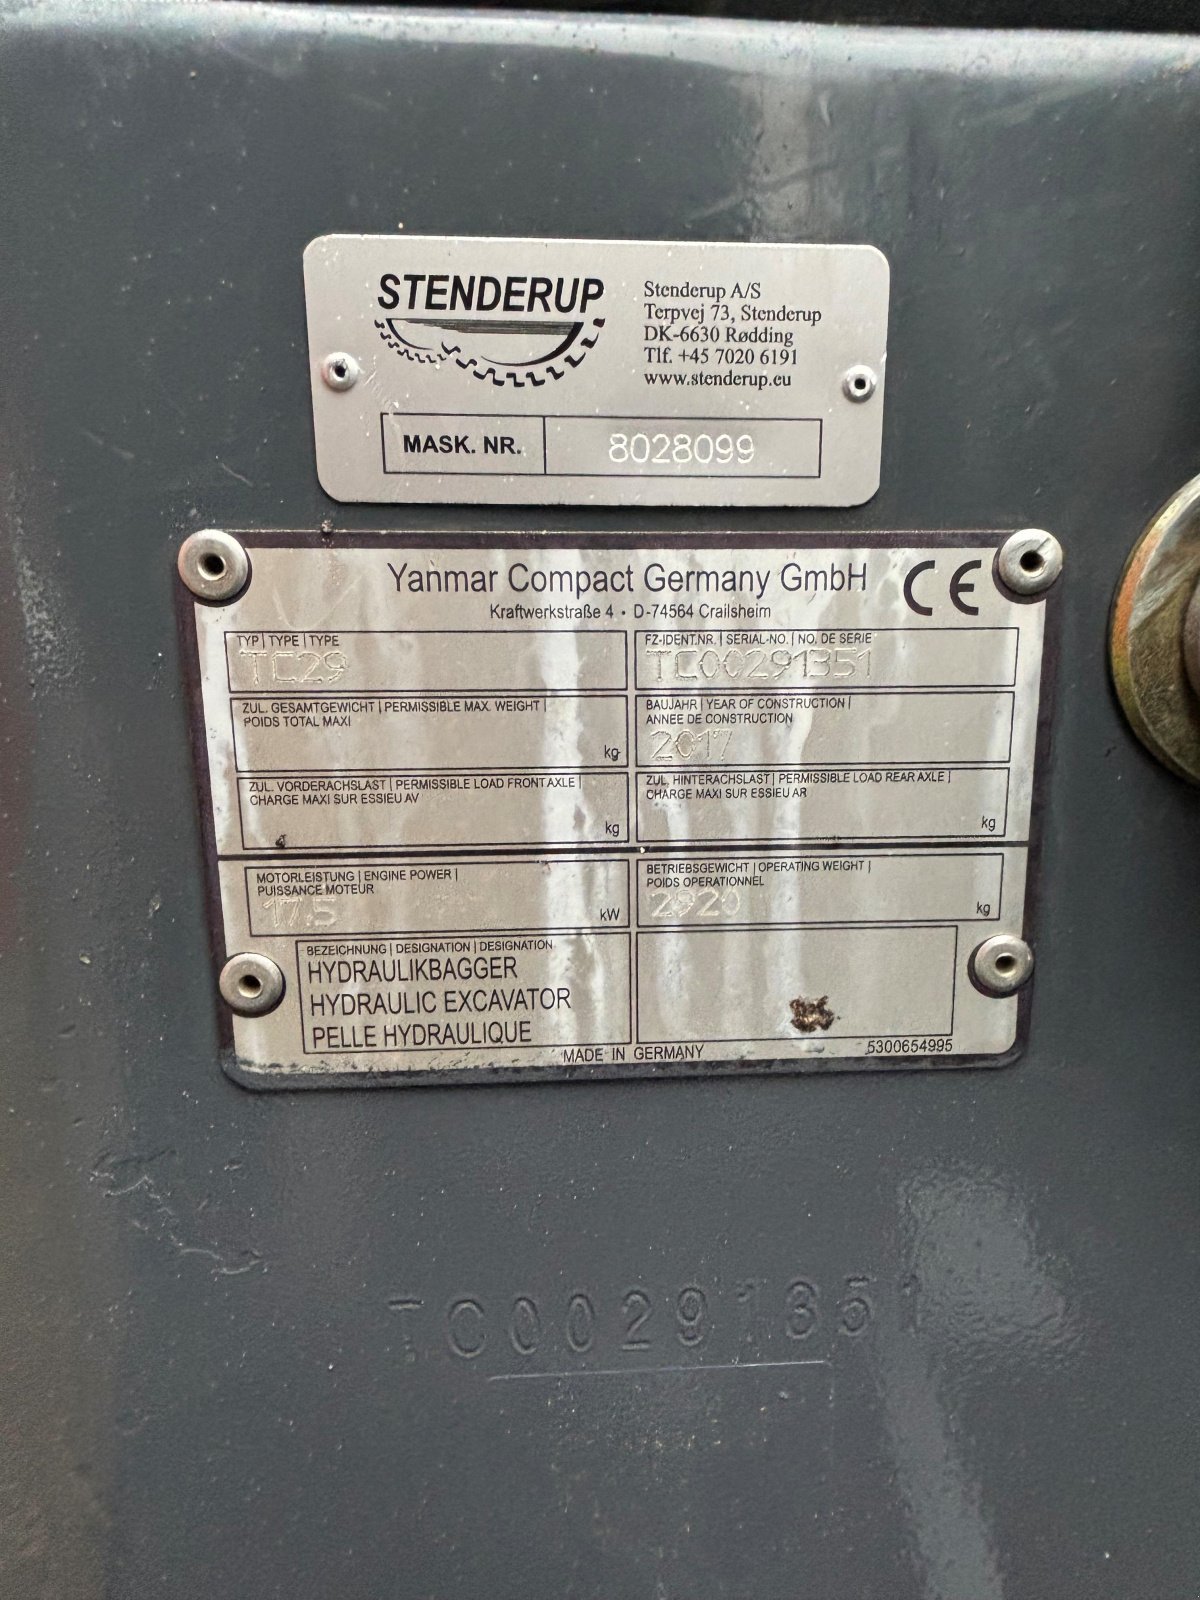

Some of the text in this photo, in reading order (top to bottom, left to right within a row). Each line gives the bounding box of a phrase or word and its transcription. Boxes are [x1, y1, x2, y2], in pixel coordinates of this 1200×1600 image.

[377, 273, 604, 313] STENDERUP
[644, 281, 761, 302] Stenderup A/S
[644, 303, 822, 326] Terpvej 73, Stenderup
[644, 325, 793, 347] DK-6630 Rødding
[644, 347, 797, 365] Tlf. +45 7020 6191
[644, 370, 792, 390] www.stenderup.eu
[403, 433, 755, 464] MASK. NR. 8028099
[387, 562, 867, 599] Yanmar Compact Germany GmbH
[904, 560, 982, 616] CE
[490, 603, 771, 619] Kraftwerkstraße 4 D-74564 Crailsheim
[237, 635, 339, 647] TYP TYPE TYPE
[822, 633, 835, 644] DE
[839, 633, 871, 644] SERIE
[239, 651, 349, 684] TC29
[646, 649, 872, 681] TC00291351
[242, 702, 268, 714] ZUL.
[271, 701, 374, 714] GESAMTGEWICHT
[385, 701, 460, 713] PERMISSIBLE
[495, 700, 540, 712] WEIGHT
[646, 698, 845, 710] BAUJAHR YEAR OF CONSTRUCTION
[244, 716, 351, 728] POIDS TOTAL MAXI
[646, 713, 793, 724] ANNEE DE CONSTRUCTION
[604, 745, 620, 761] kg
[249, 777, 575, 793] ZUL. VORDERACHSLAST PERMISSIBLE LOAD FRONT AXLE
[646, 771, 945, 786] ZUL. HINTERACHSLAST PERMISSIBLE LOAD REAR AXLE
[250, 792, 419, 806] CHARGE MAXI SUR ESSIEU AV
[646, 787, 807, 800] CHARGE MAXI SUR ESSIEU AR
[605, 821, 620, 837] kg
[982, 816, 996, 831] kg
[647, 861, 865, 874] BETRIEBSGEWICHT OPERATING WEIGHT
[257, 869, 452, 884] MOTORLEISTUNG ENGINE POWER
[647, 876, 764, 888] POIDS OPERATIONNEL
[258, 884, 374, 896] PUISSANCE MOTEUR
[600, 908, 620, 921] kW
[977, 901, 990, 917] kg
[307, 939, 553, 955] BEZEICHNUNG DESIGNATION DESIGNATION
[308, 957, 517, 984] HYDRAULIKBAGGER
[310, 988, 571, 1017] HYDRAULIC EXCAVATOR
[312, 1021, 531, 1049] PELLE HYDRAULIQUE
[563, 1046, 704, 1063] MADE IN GERMANY
[867, 1039, 953, 1054] 5300654995
